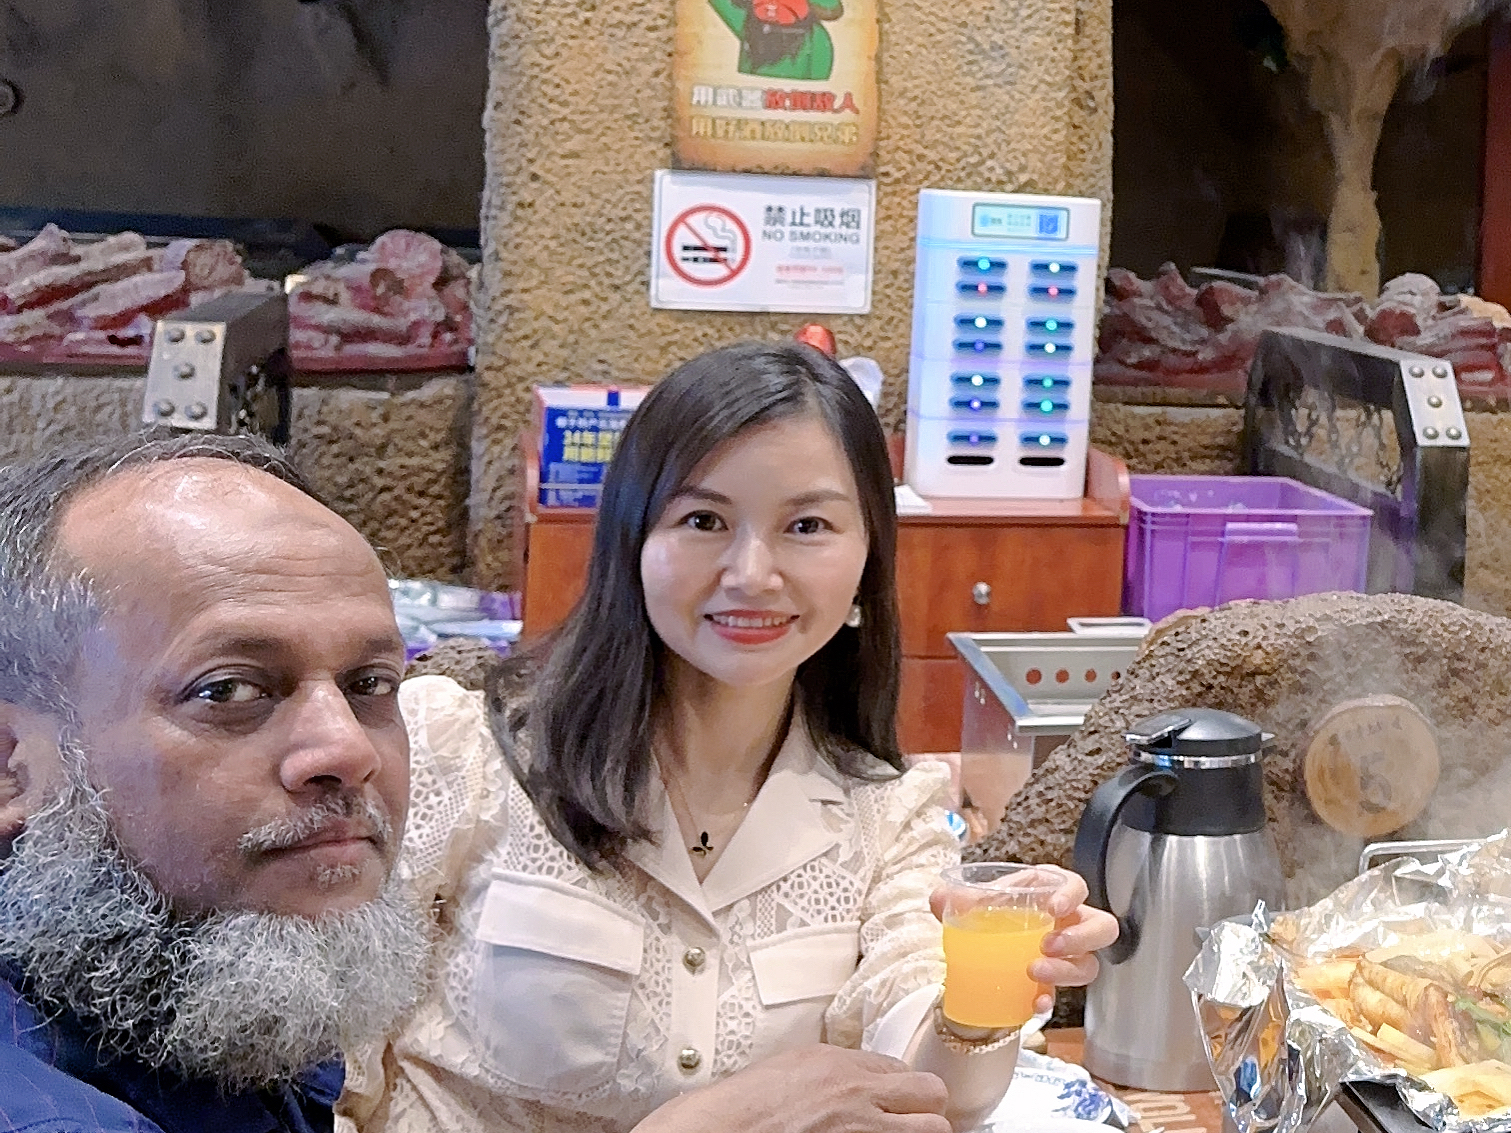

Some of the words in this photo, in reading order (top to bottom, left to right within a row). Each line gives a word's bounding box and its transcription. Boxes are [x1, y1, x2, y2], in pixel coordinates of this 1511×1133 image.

[763, 204, 862, 230] 禁止吸烟
[762, 228, 785, 242] NO
[789, 230, 860, 245] SMOKING
